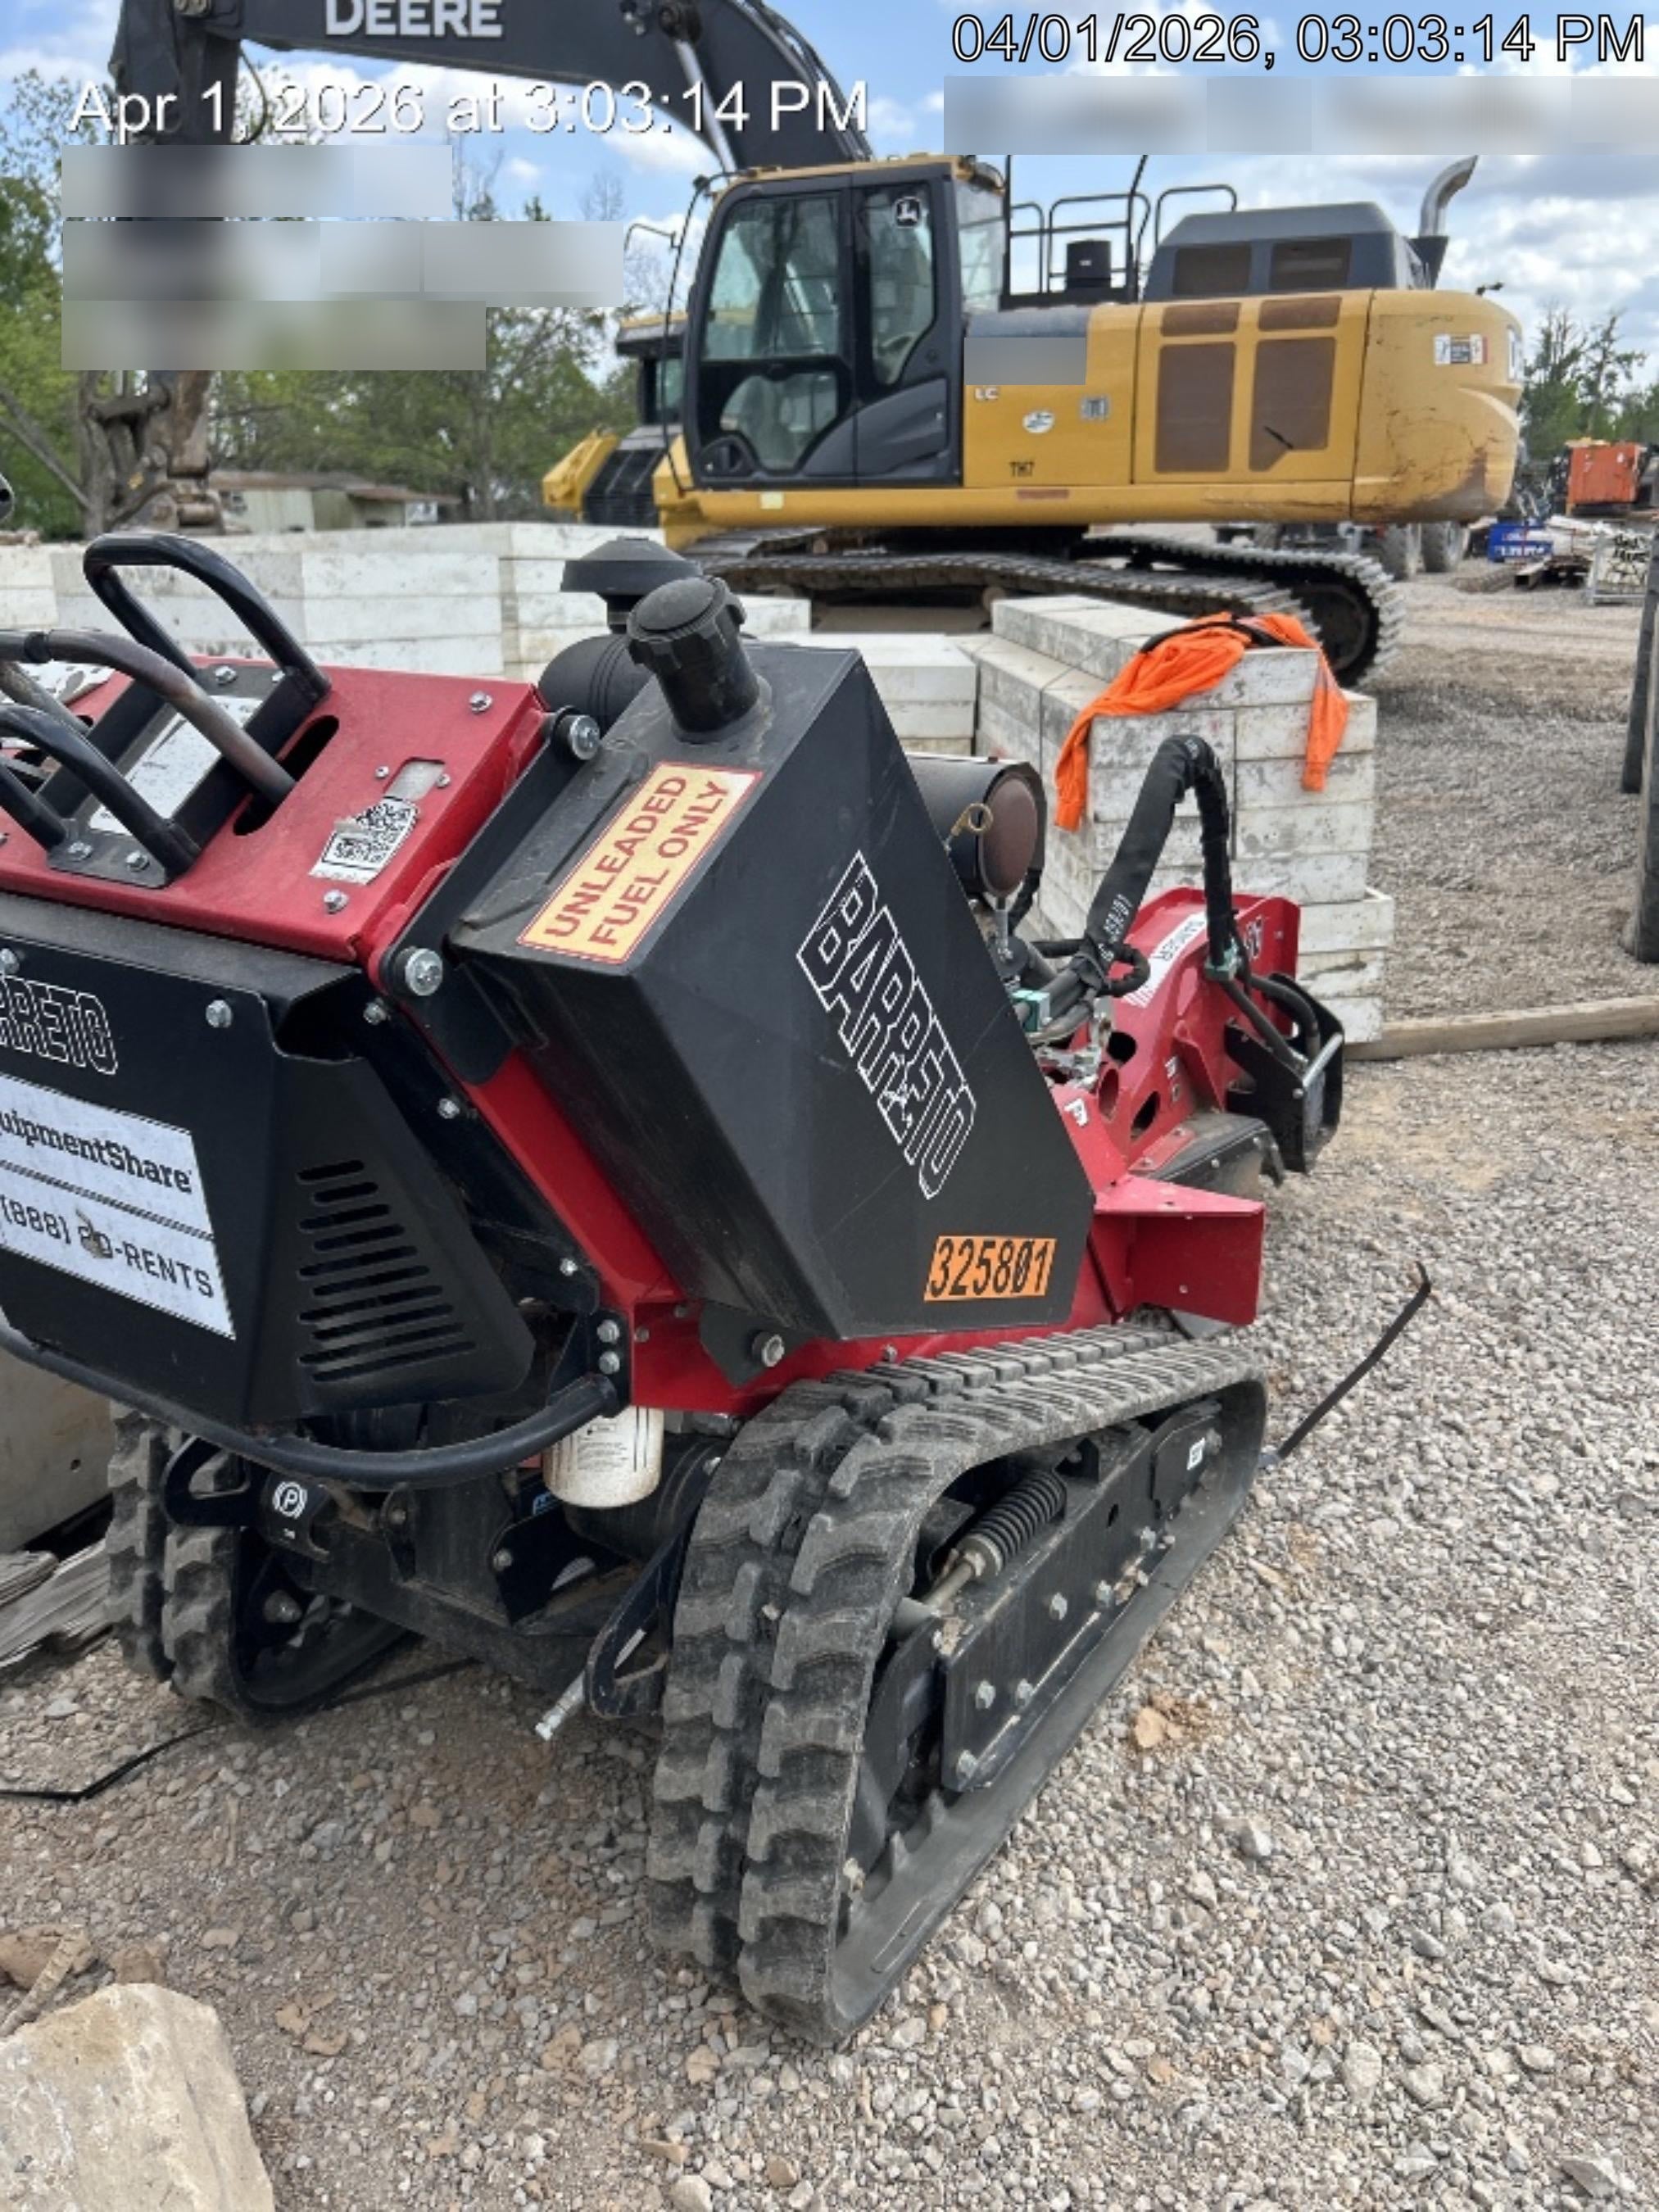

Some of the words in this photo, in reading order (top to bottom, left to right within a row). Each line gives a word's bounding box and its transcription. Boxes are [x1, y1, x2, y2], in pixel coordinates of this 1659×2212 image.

[325, 0, 503, 38] DEERE
[543, 777, 687, 937] UNLEADED
[587, 868, 670, 945] FUEL
[657, 780, 729, 859] ONLY
[796, 850, 977, 1199] BARRETO
[0, 1108, 193, 1194] uipmentShare
[931, 1238, 1049, 1298] 325801
